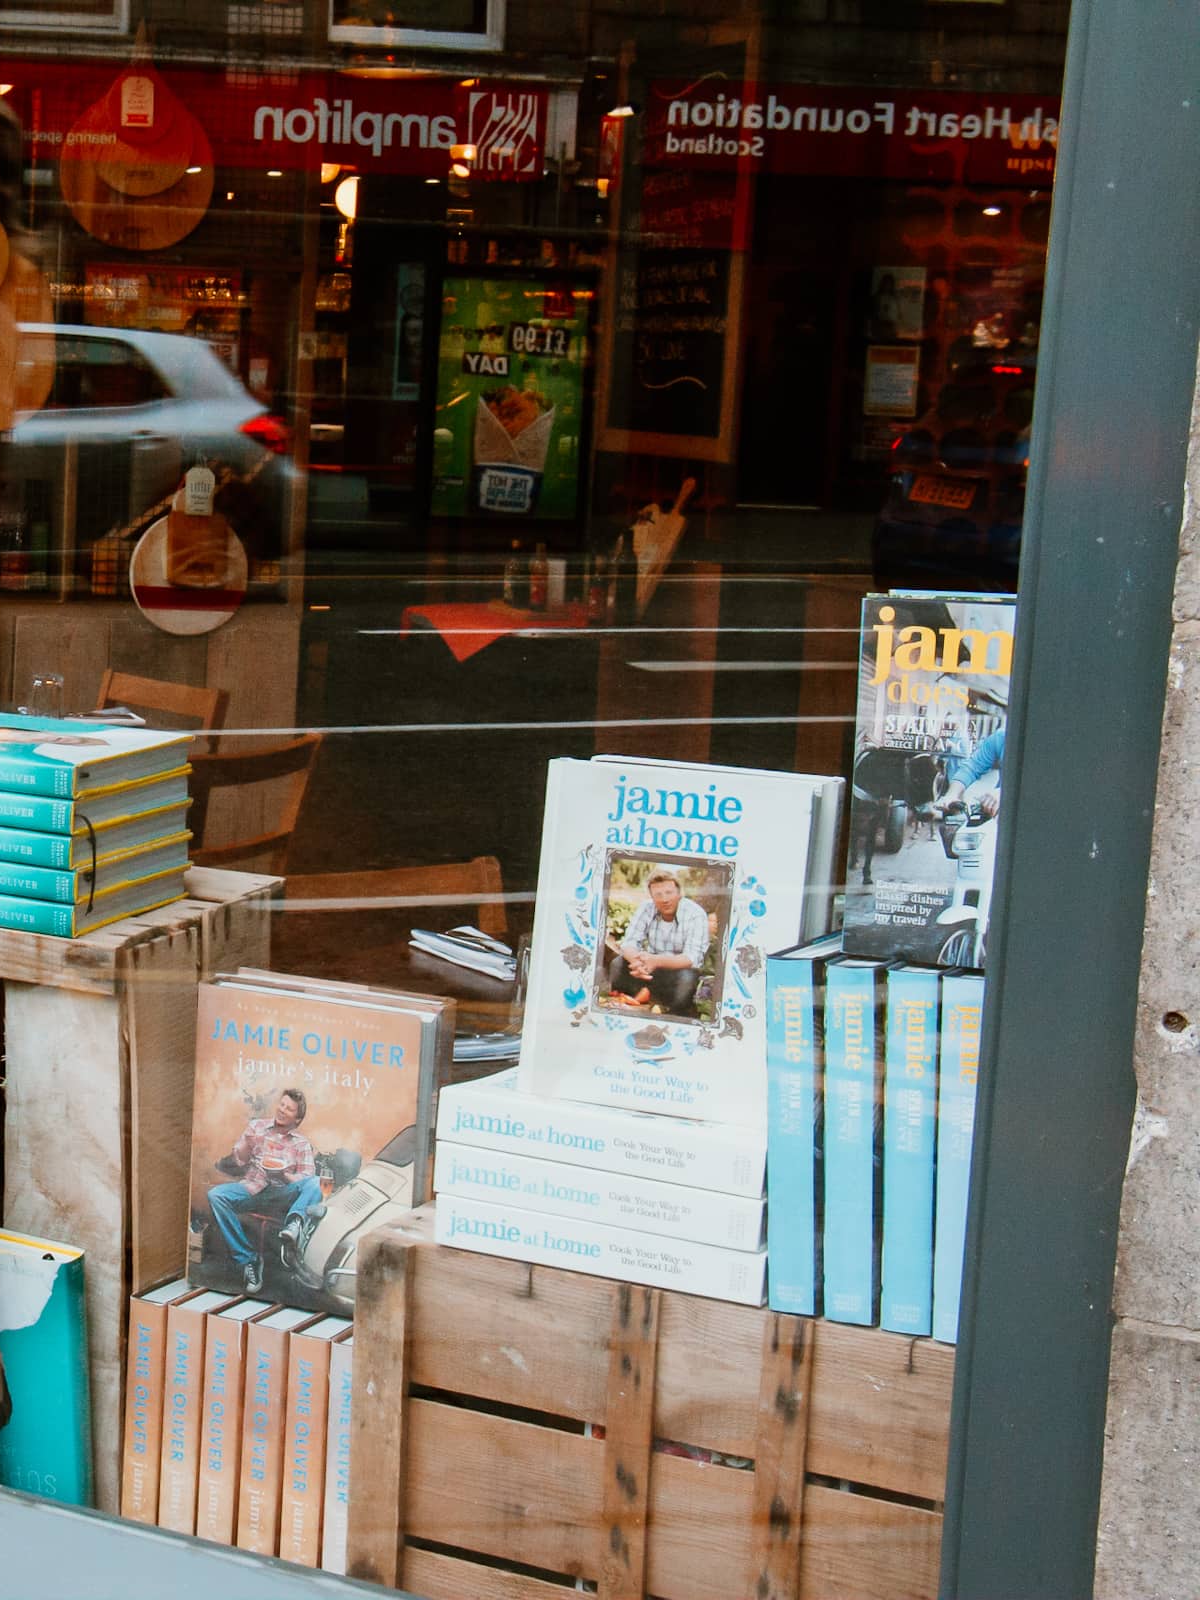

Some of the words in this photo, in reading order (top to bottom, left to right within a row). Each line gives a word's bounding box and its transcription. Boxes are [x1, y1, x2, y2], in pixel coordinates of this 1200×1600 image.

[607, 775, 743, 825] jamie
[874, 912, 890, 924] my
[892, 914, 927, 927] travels
[875, 902, 918, 916] inspired
[919, 904, 932, 917] by
[911, 892, 944, 906] dishes
[211, 1017, 291, 1051] JAMIE
[302, 1032, 406, 1070] OLIVER
[778, 985, 809, 1062] jamie
[840, 993, 870, 1070] jamie
[902, 999, 933, 1080] jamie
[237, 1051, 314, 1082] jamie's
[325, 1064, 376, 1097] italy
[594, 1065, 625, 1081] Cook
[630, 1069, 661, 1086] Your
[666, 1074, 693, 1092] Way
[697, 1080, 709, 1092] to
[610, 1083, 630, 1095] the
[633, 1084, 666, 1101] Good
[671, 1089, 695, 1105] Life
[451, 1106, 526, 1139] jamie
[527, 1124, 543, 1141] at
[547, 1125, 606, 1153] home
[448, 1158, 521, 1191] jamie
[542, 1177, 601, 1206] home
[447, 1210, 521, 1243] jamie
[523, 1229, 539, 1246] at
[542, 1231, 601, 1258] home
[135, 1323, 151, 1380] JAMIE
[174, 1330, 189, 1387] JAMIE
[212, 1340, 227, 1396] JAMIE
[254, 1349, 271, 1408] JAMIE
[297, 1360, 313, 1416] JAMIE
[133, 1385, 148, 1454] OLIVER
[171, 1393, 187, 1462] OLIVER
[208, 1401, 225, 1472] OLIVER
[251, 1412, 268, 1482] OLIVER
[293, 1422, 310, 1493] OLIVER
